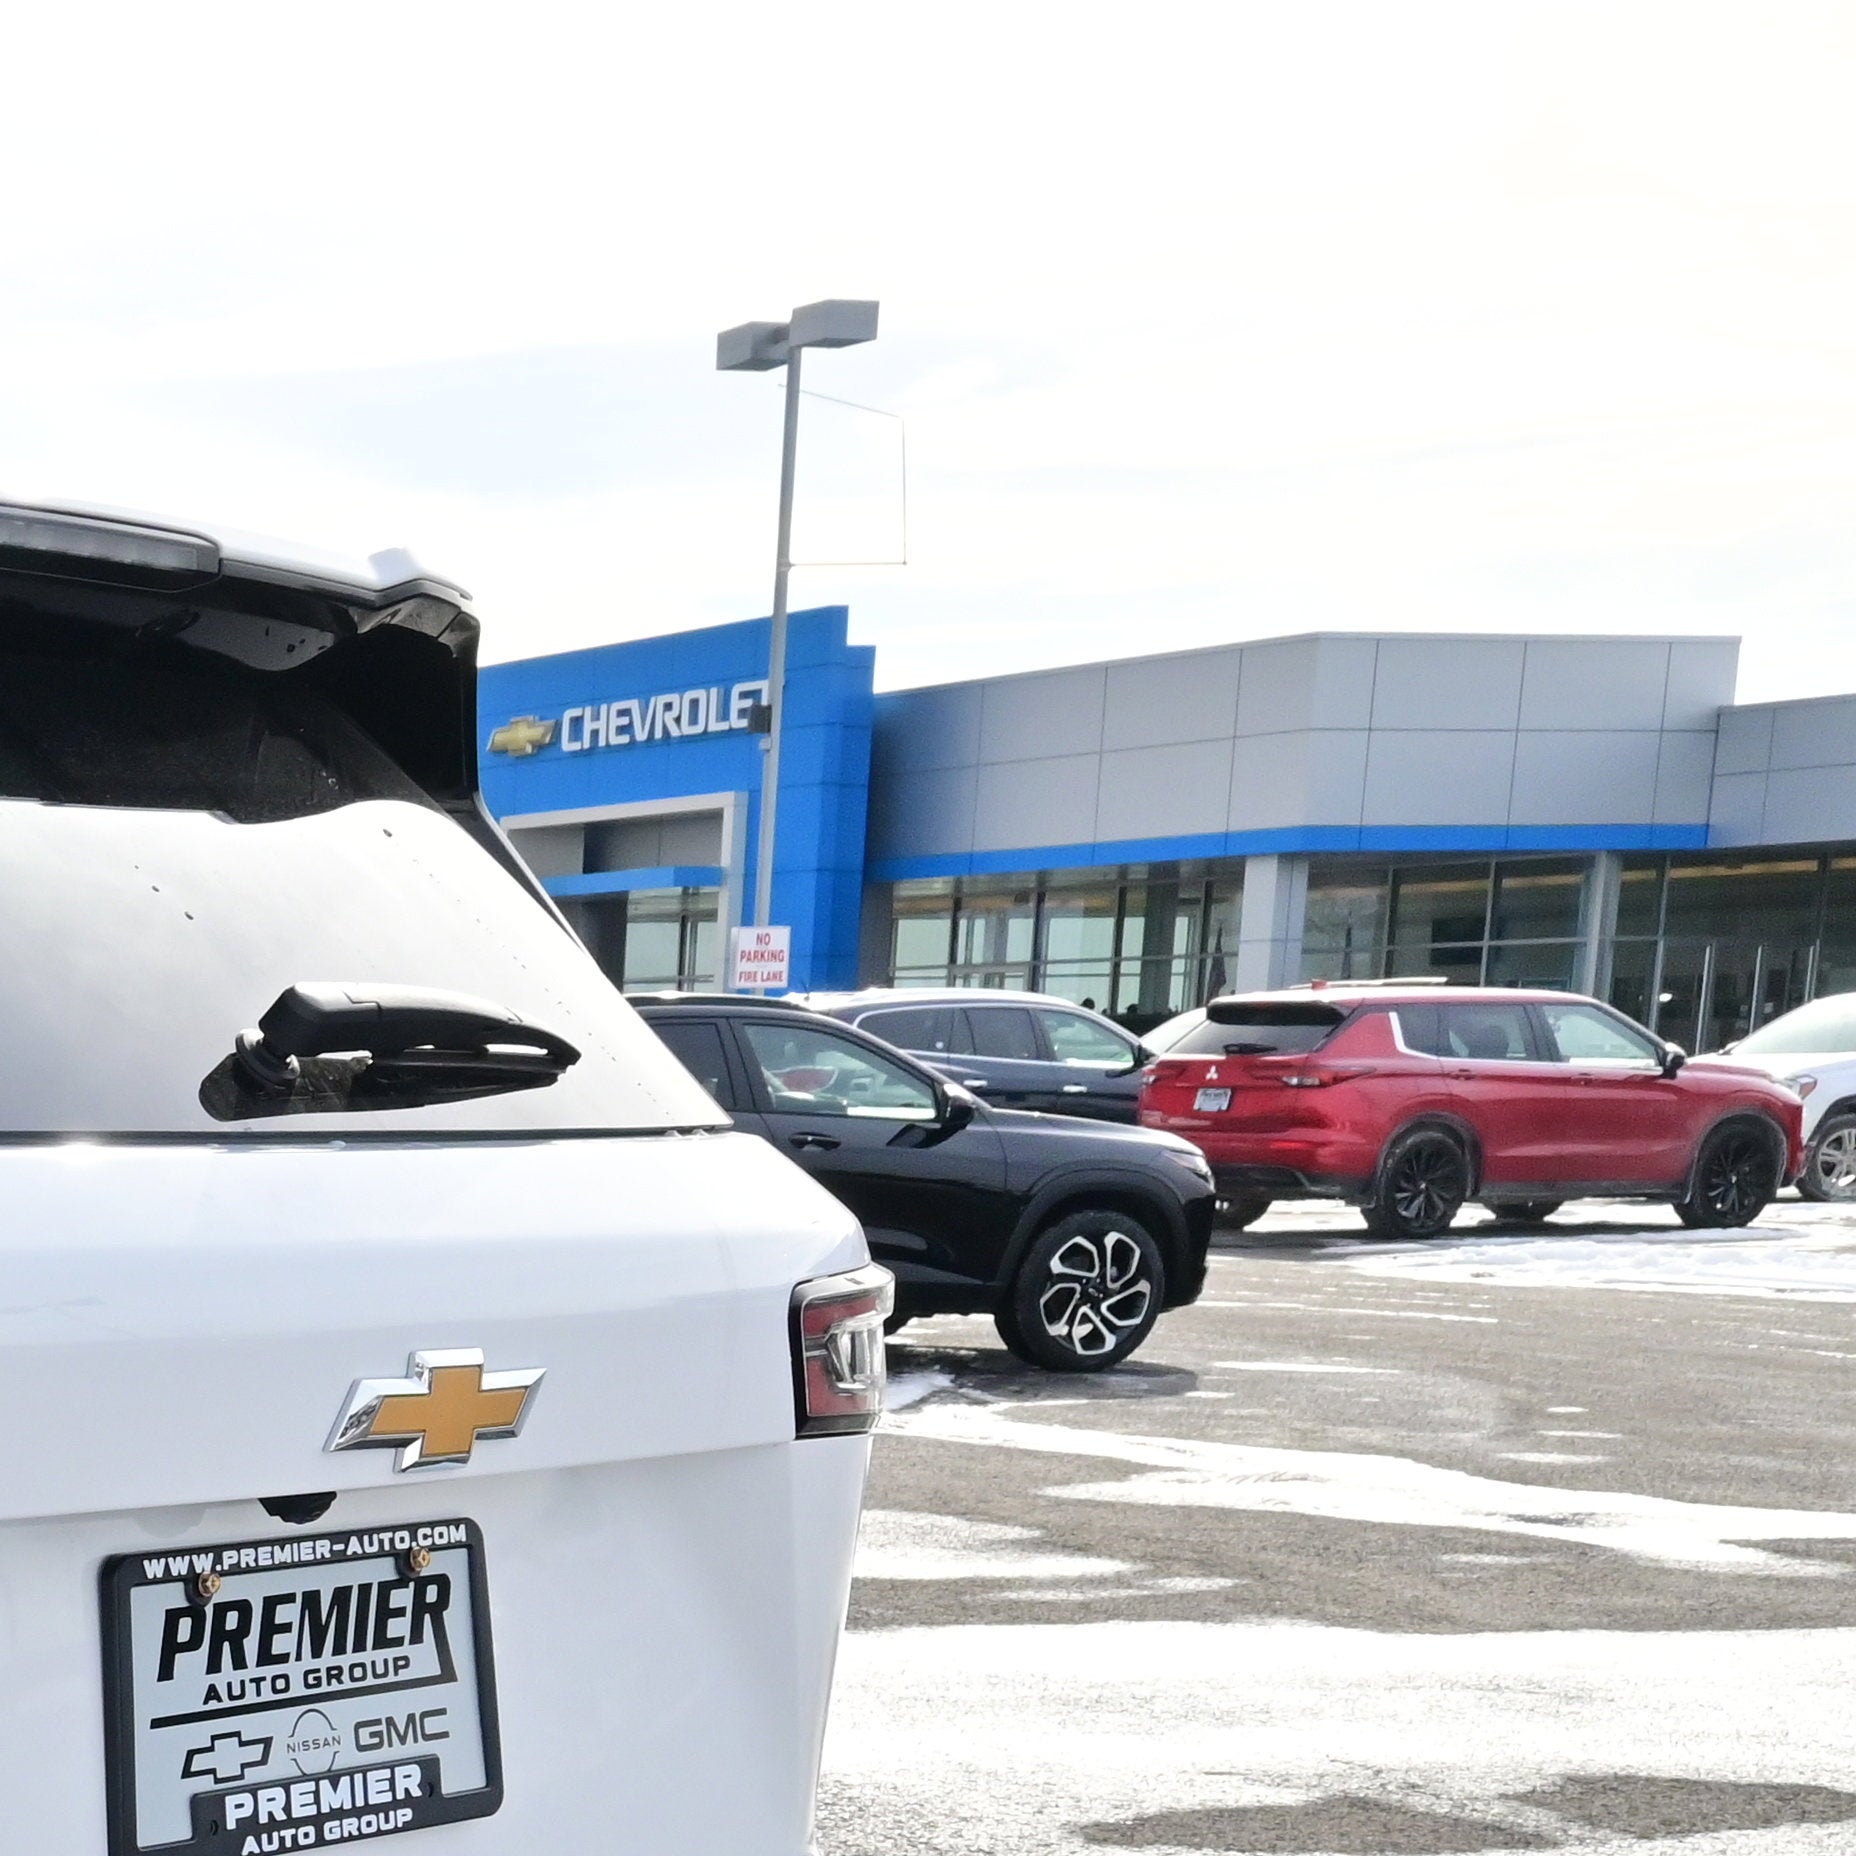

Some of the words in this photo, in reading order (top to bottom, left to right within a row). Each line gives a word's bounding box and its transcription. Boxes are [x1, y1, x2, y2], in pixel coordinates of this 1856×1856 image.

[740, 949, 785, 962] PARKING
[756, 932, 771, 946] NO
[739, 970, 758, 983] FIRE
[761, 970, 784, 982] LANE
[142, 1523, 467, 1580] WWW.PREMIER-AUTO.COM
[156, 1572, 454, 1684] PREMIER
[202, 1672, 291, 1706] AUTO
[302, 1654, 411, 1690] GROUP
[287, 1734, 342, 1754] NISSAN
[353, 1706, 450, 1753] GMC
[224, 1763, 423, 1831] PREMIER
[241, 1828, 316, 1856] AUTO
[322, 1807, 414, 1841] GROUP
